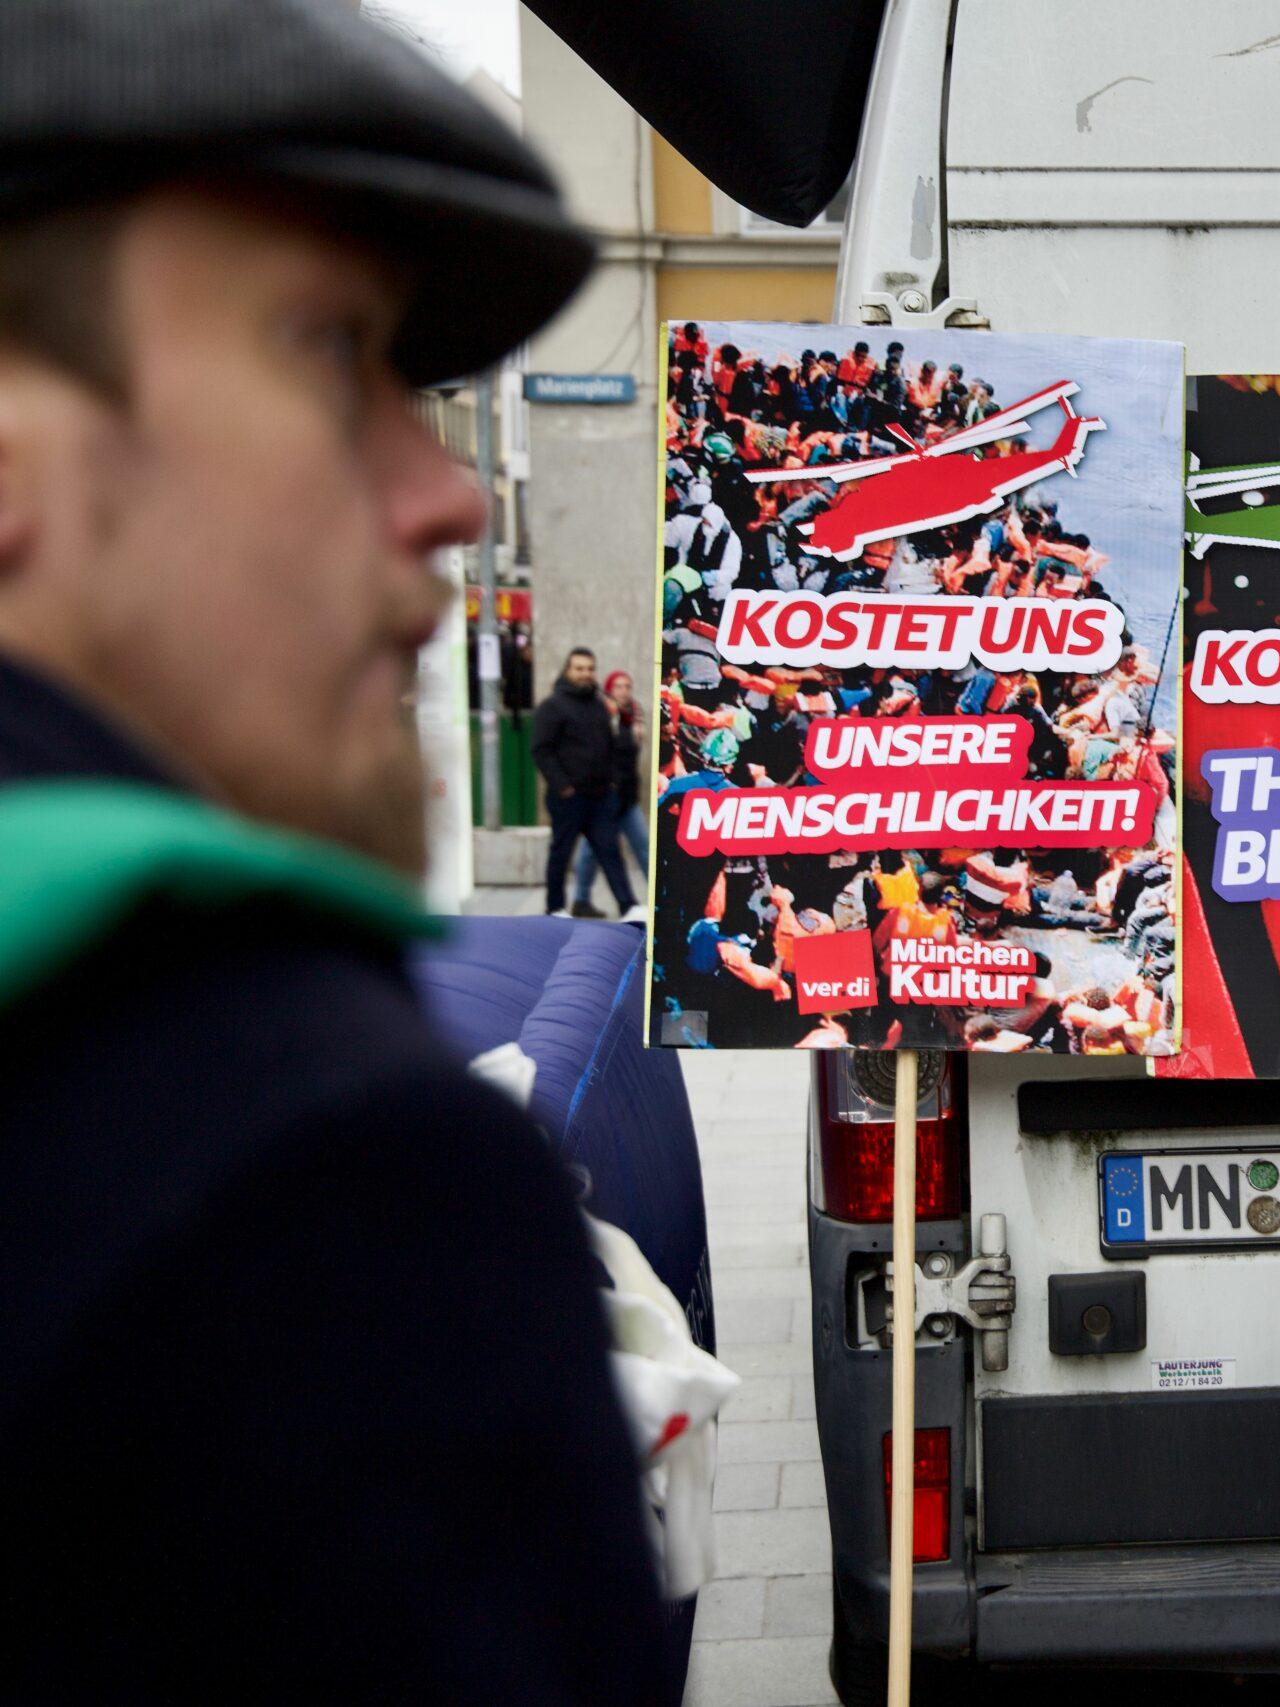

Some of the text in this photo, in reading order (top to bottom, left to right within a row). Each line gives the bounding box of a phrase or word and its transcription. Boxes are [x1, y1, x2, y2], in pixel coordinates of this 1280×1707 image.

[535, 377, 625, 399] Marienplatz
[728, 600, 1107, 656] KOSTET UNS
[813, 722, 1017, 769] UNSERE
[685, 788, 1141, 840] MENSCHLICHKEIT!
[890, 938, 1029, 967] München
[890, 966, 1029, 1001] Kultur
[1117, 1208, 1132, 1227] D
[1150, 1164, 1241, 1231] MN
